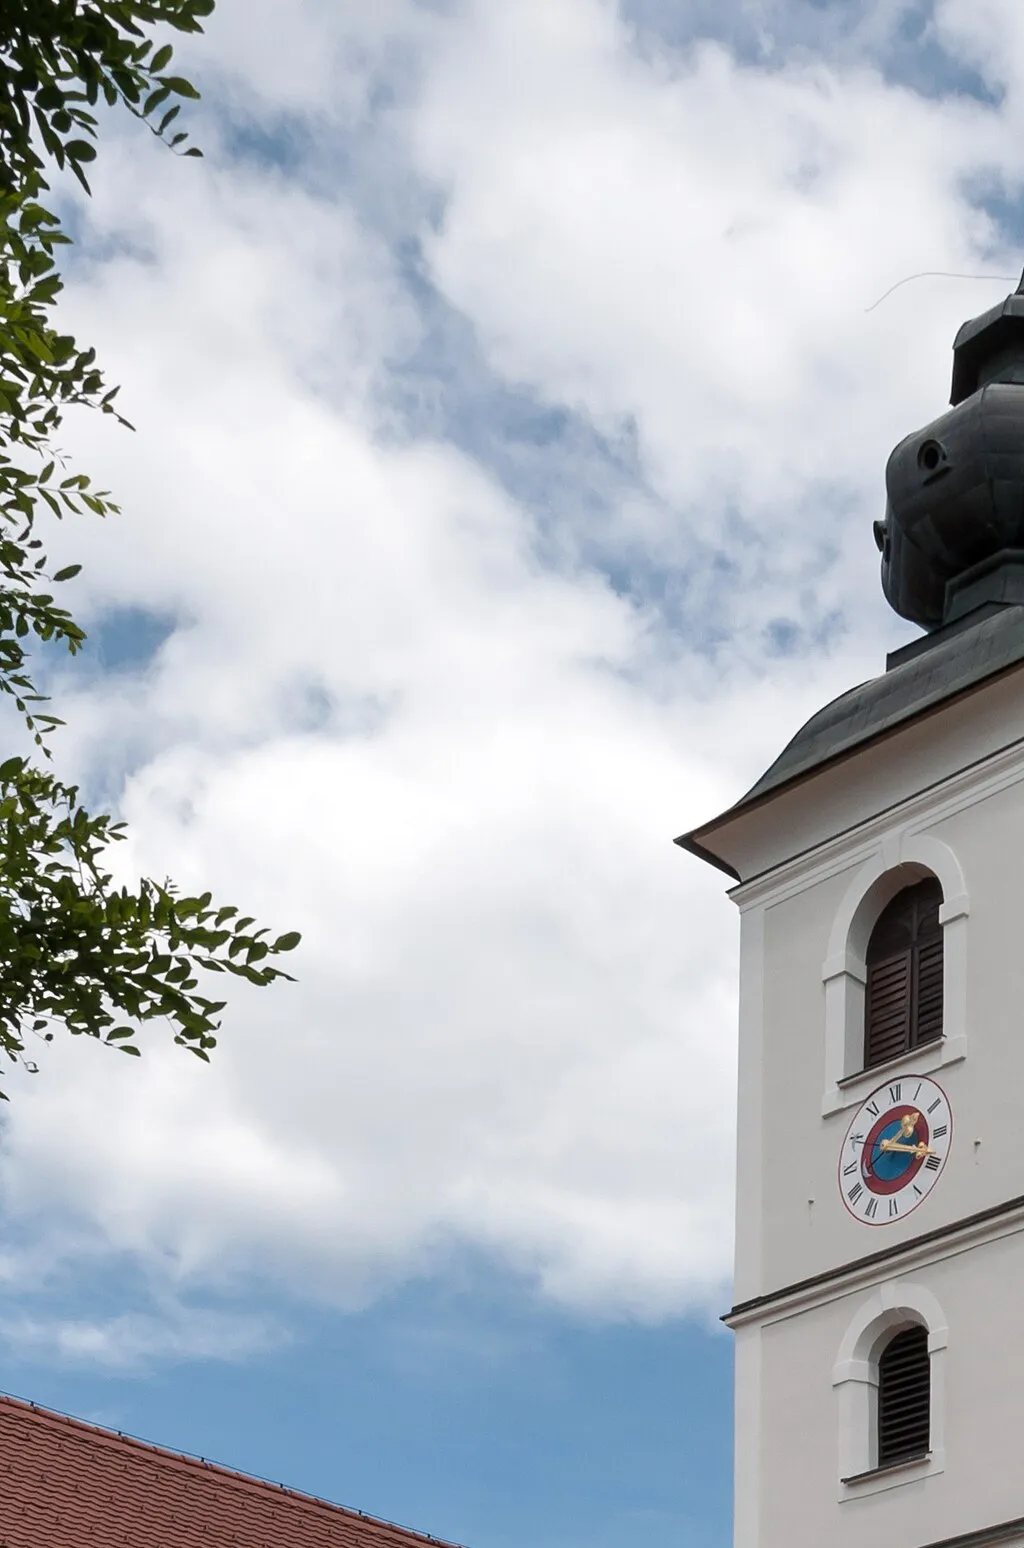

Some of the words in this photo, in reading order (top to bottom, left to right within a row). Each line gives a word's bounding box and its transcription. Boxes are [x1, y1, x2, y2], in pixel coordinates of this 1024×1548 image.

[927, 1098, 942, 1114] II
[933, 1125, 948, 1139] III
[925, 1155, 942, 1171] IIII
